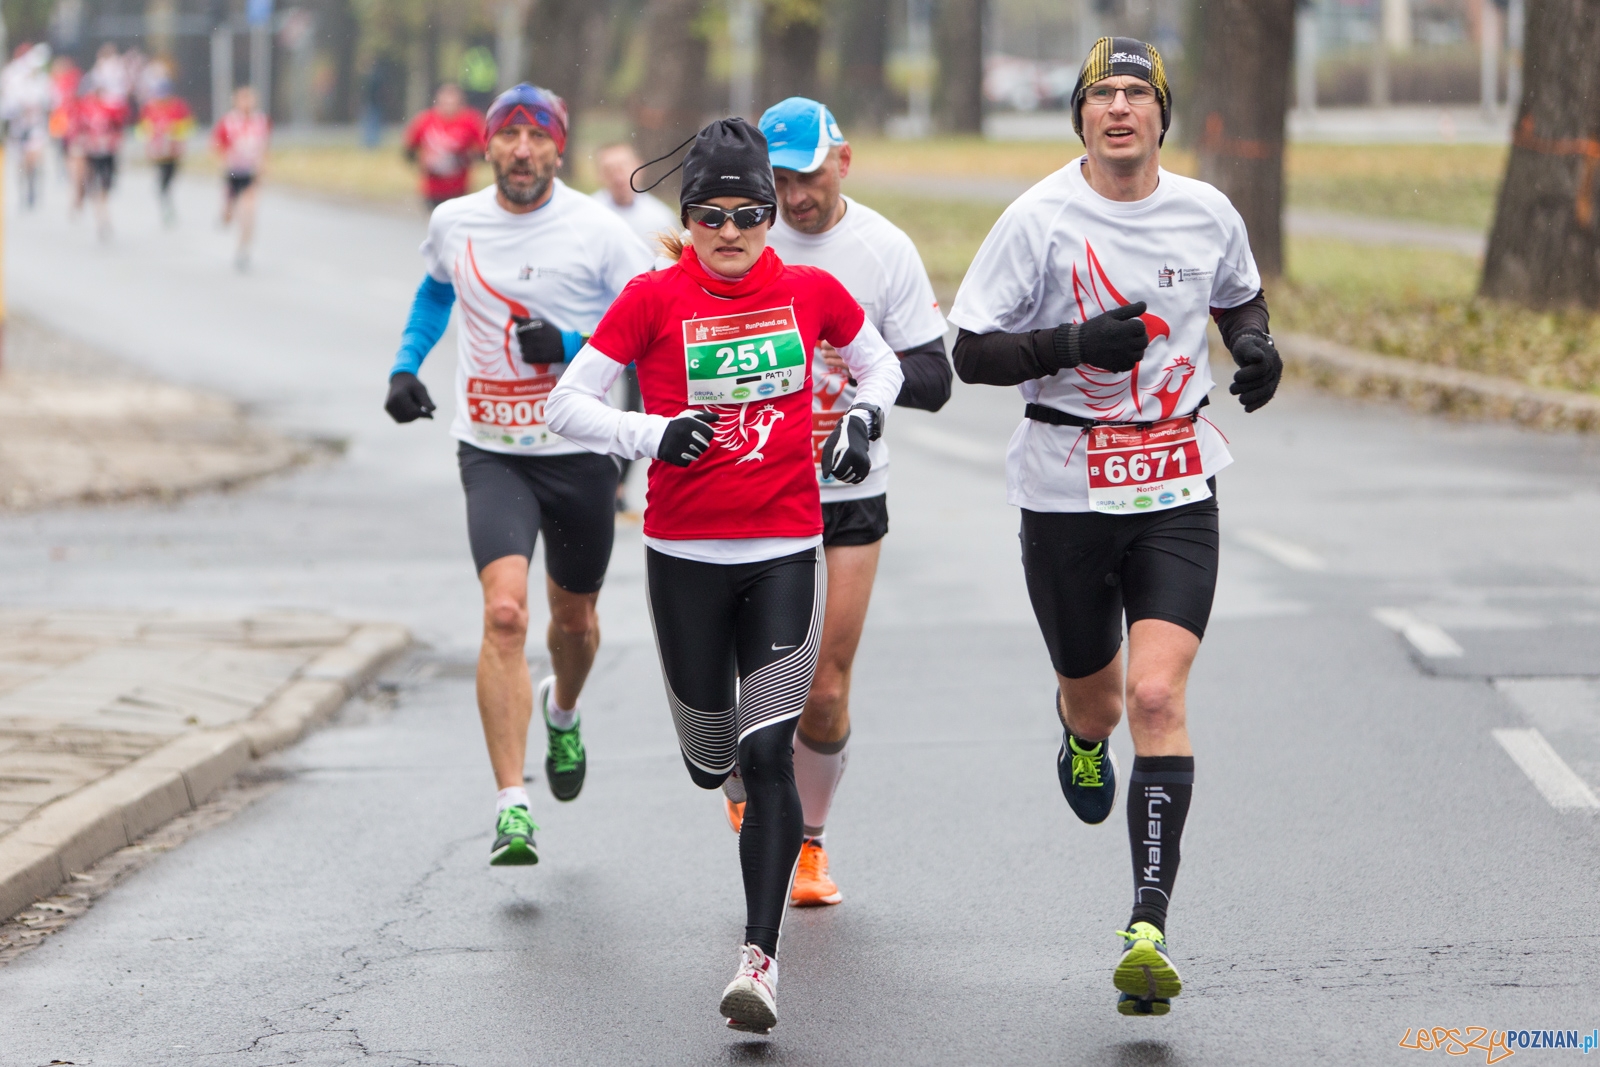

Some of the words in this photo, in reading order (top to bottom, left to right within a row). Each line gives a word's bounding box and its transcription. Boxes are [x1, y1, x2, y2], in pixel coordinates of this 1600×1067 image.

[744, 318, 788, 330] RunPoland.org
[690, 359, 700, 369] C
[715, 340, 778, 376] 251
[479, 399, 546, 426] 3900
[1090, 466, 1100, 476] B
[1104, 446, 1188, 484] 6671
[1136, 484, 1165, 493] Norbert
